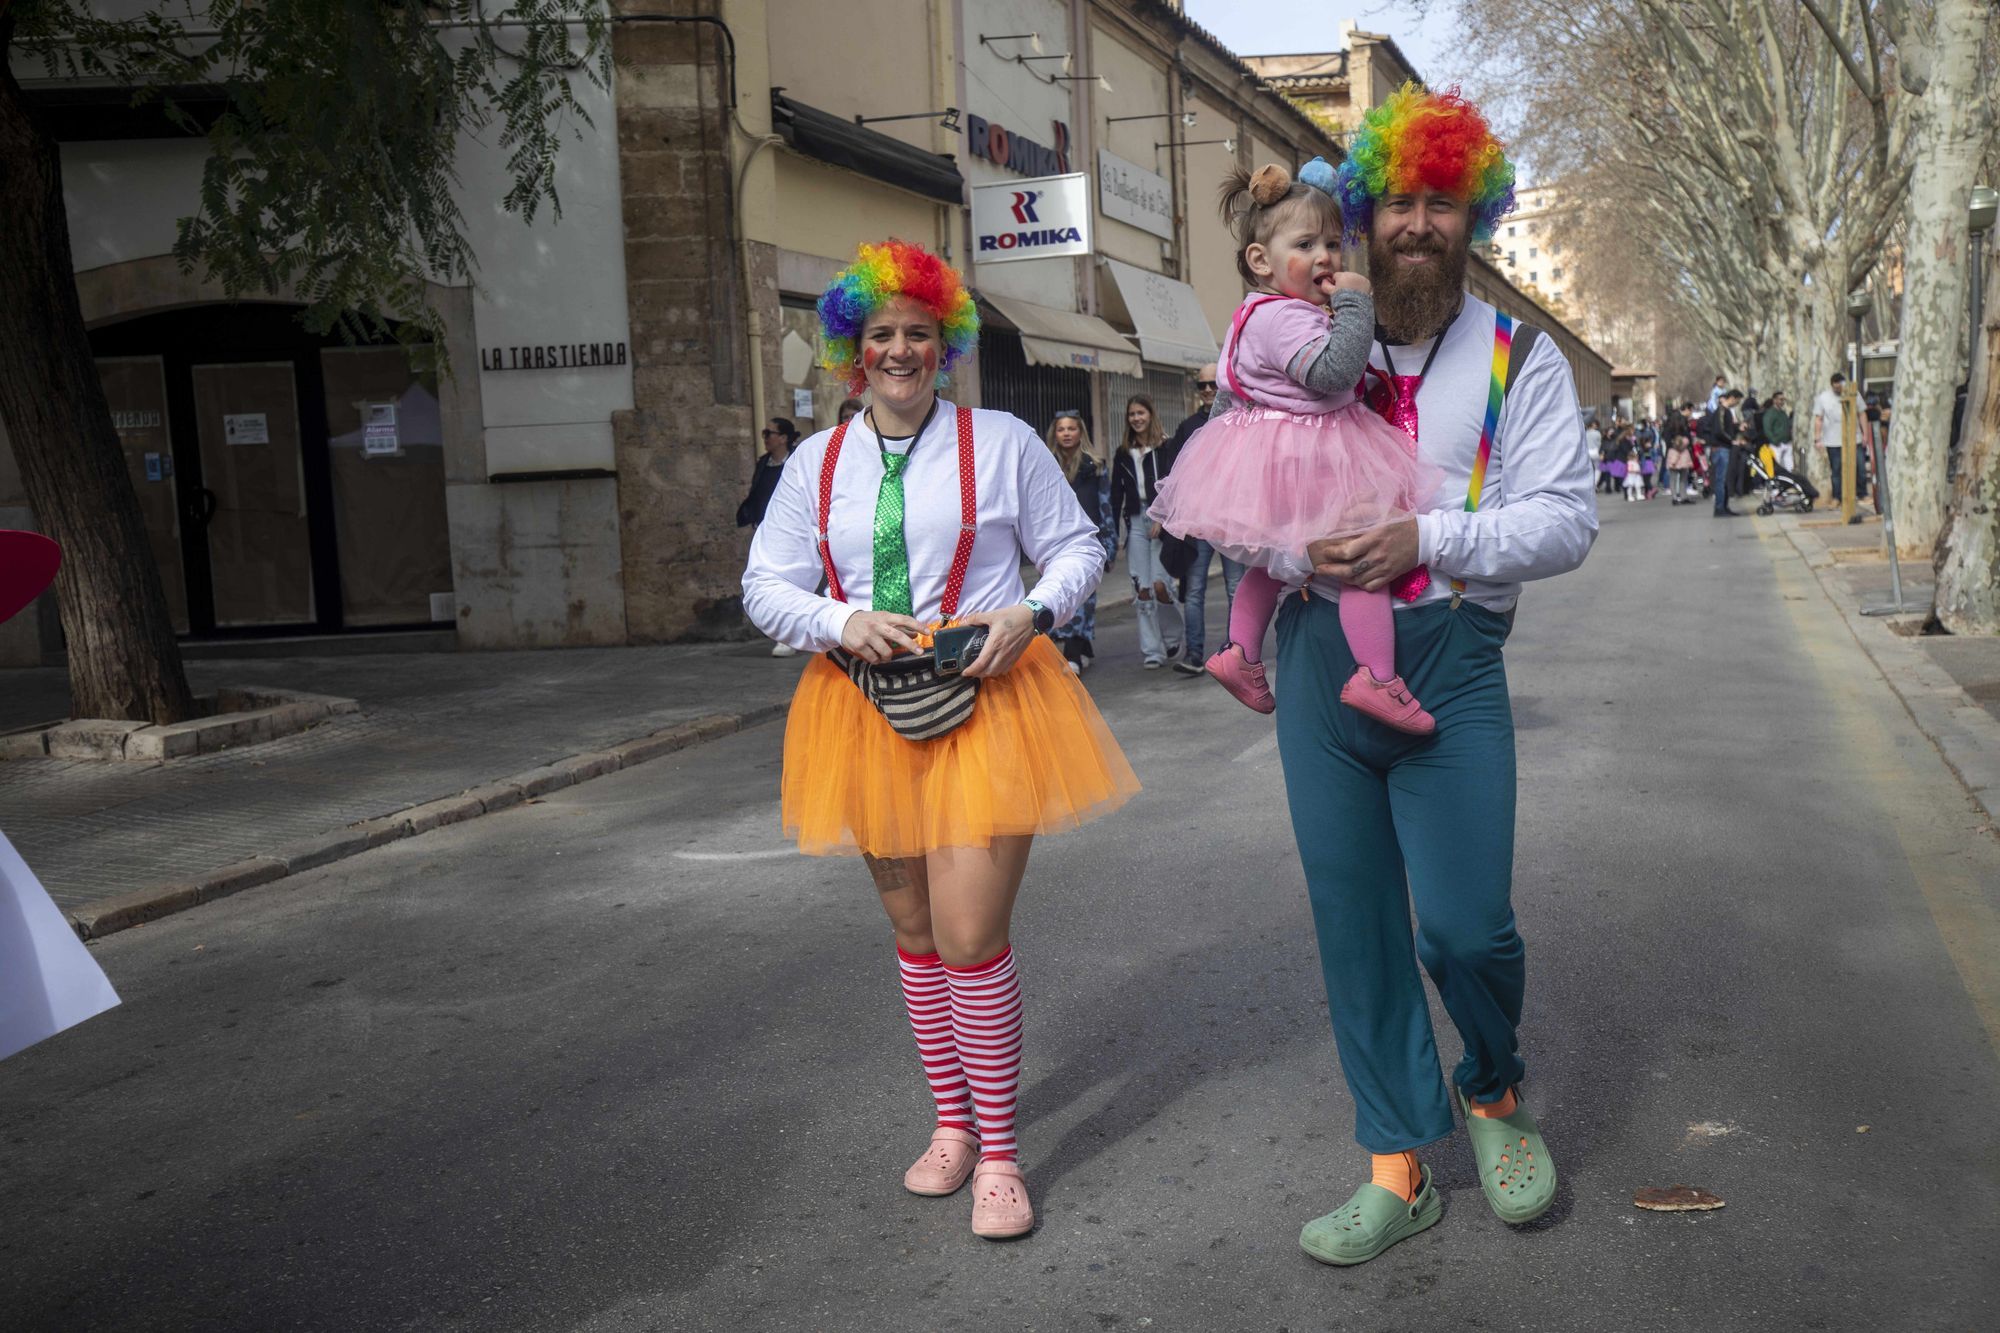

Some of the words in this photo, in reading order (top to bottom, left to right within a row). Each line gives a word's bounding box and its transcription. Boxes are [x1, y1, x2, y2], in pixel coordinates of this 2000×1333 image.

[968, 113, 1060, 178] ROMIKA
[979, 227, 1082, 251] ROMIKA
[482, 348, 502, 370] LA
[510, 343, 626, 369] TRASTIENDA
